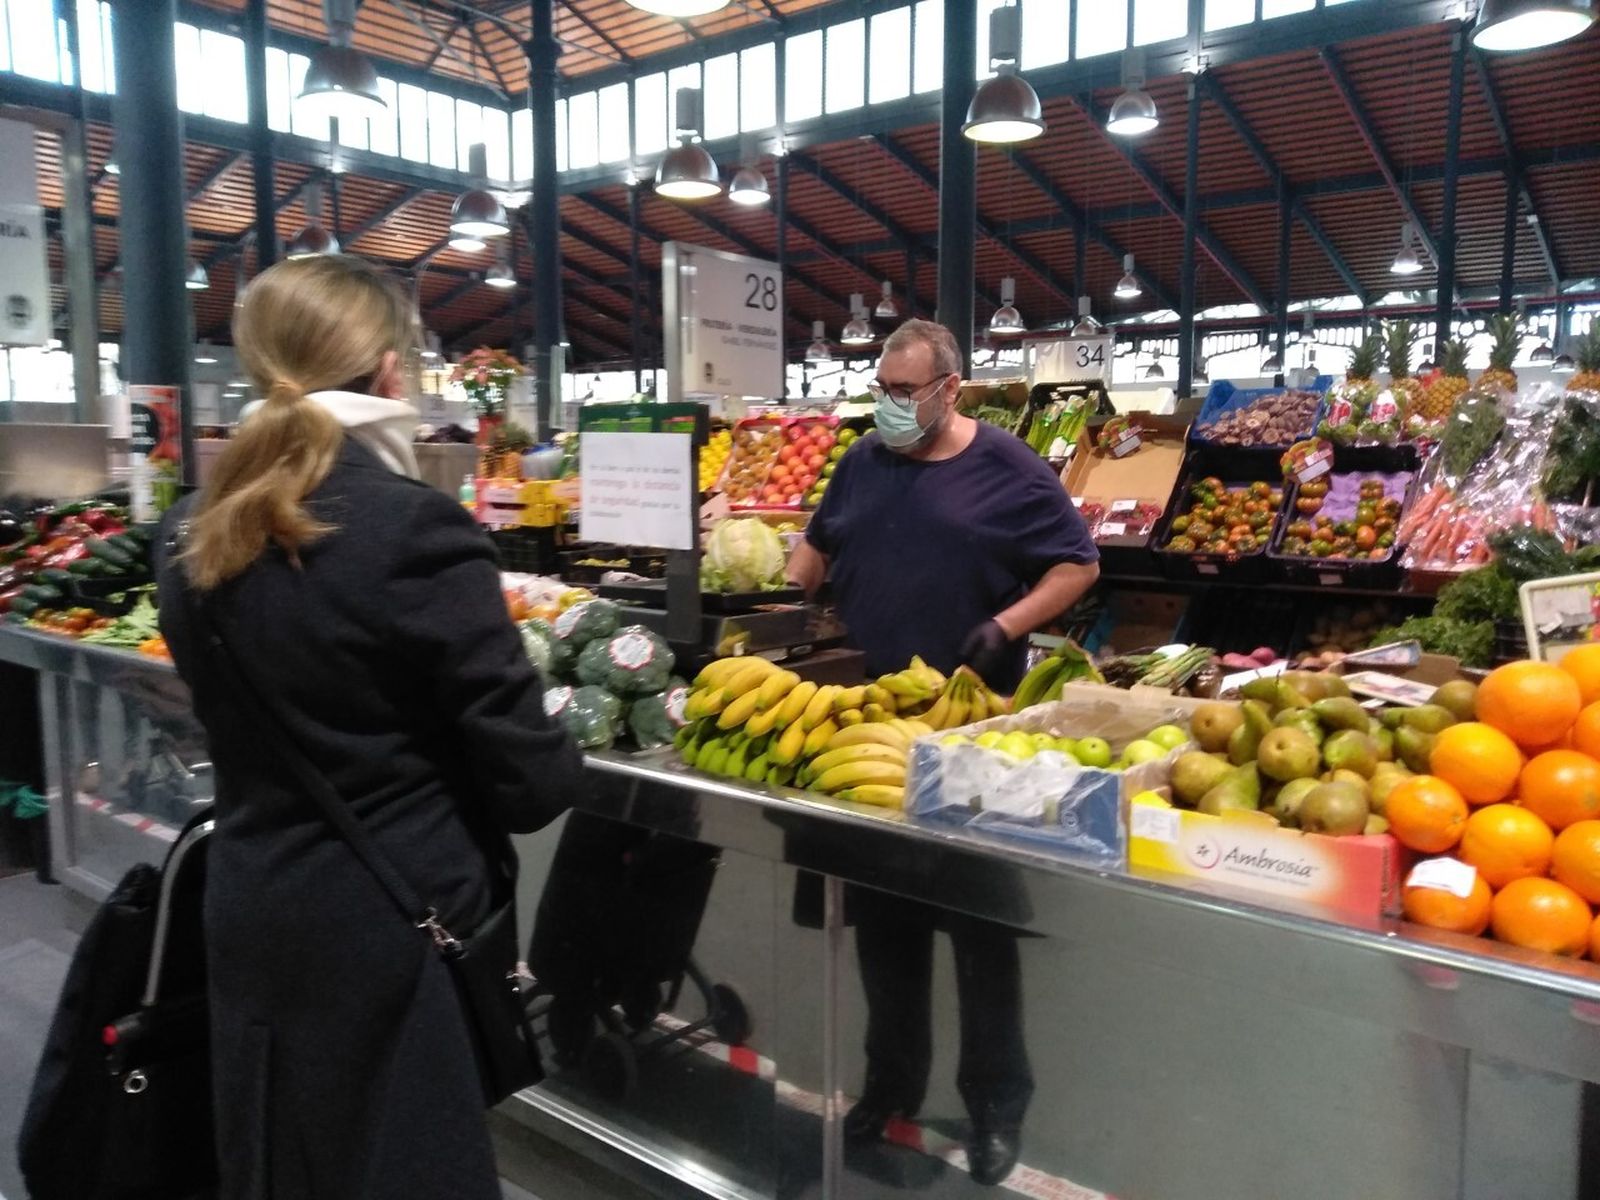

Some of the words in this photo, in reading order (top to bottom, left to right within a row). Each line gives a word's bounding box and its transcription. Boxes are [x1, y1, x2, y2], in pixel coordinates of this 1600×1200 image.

[745, 273, 778, 312] 28
[1076, 344, 1105, 368] 34
[1223, 846, 1312, 878] Ambrosia
